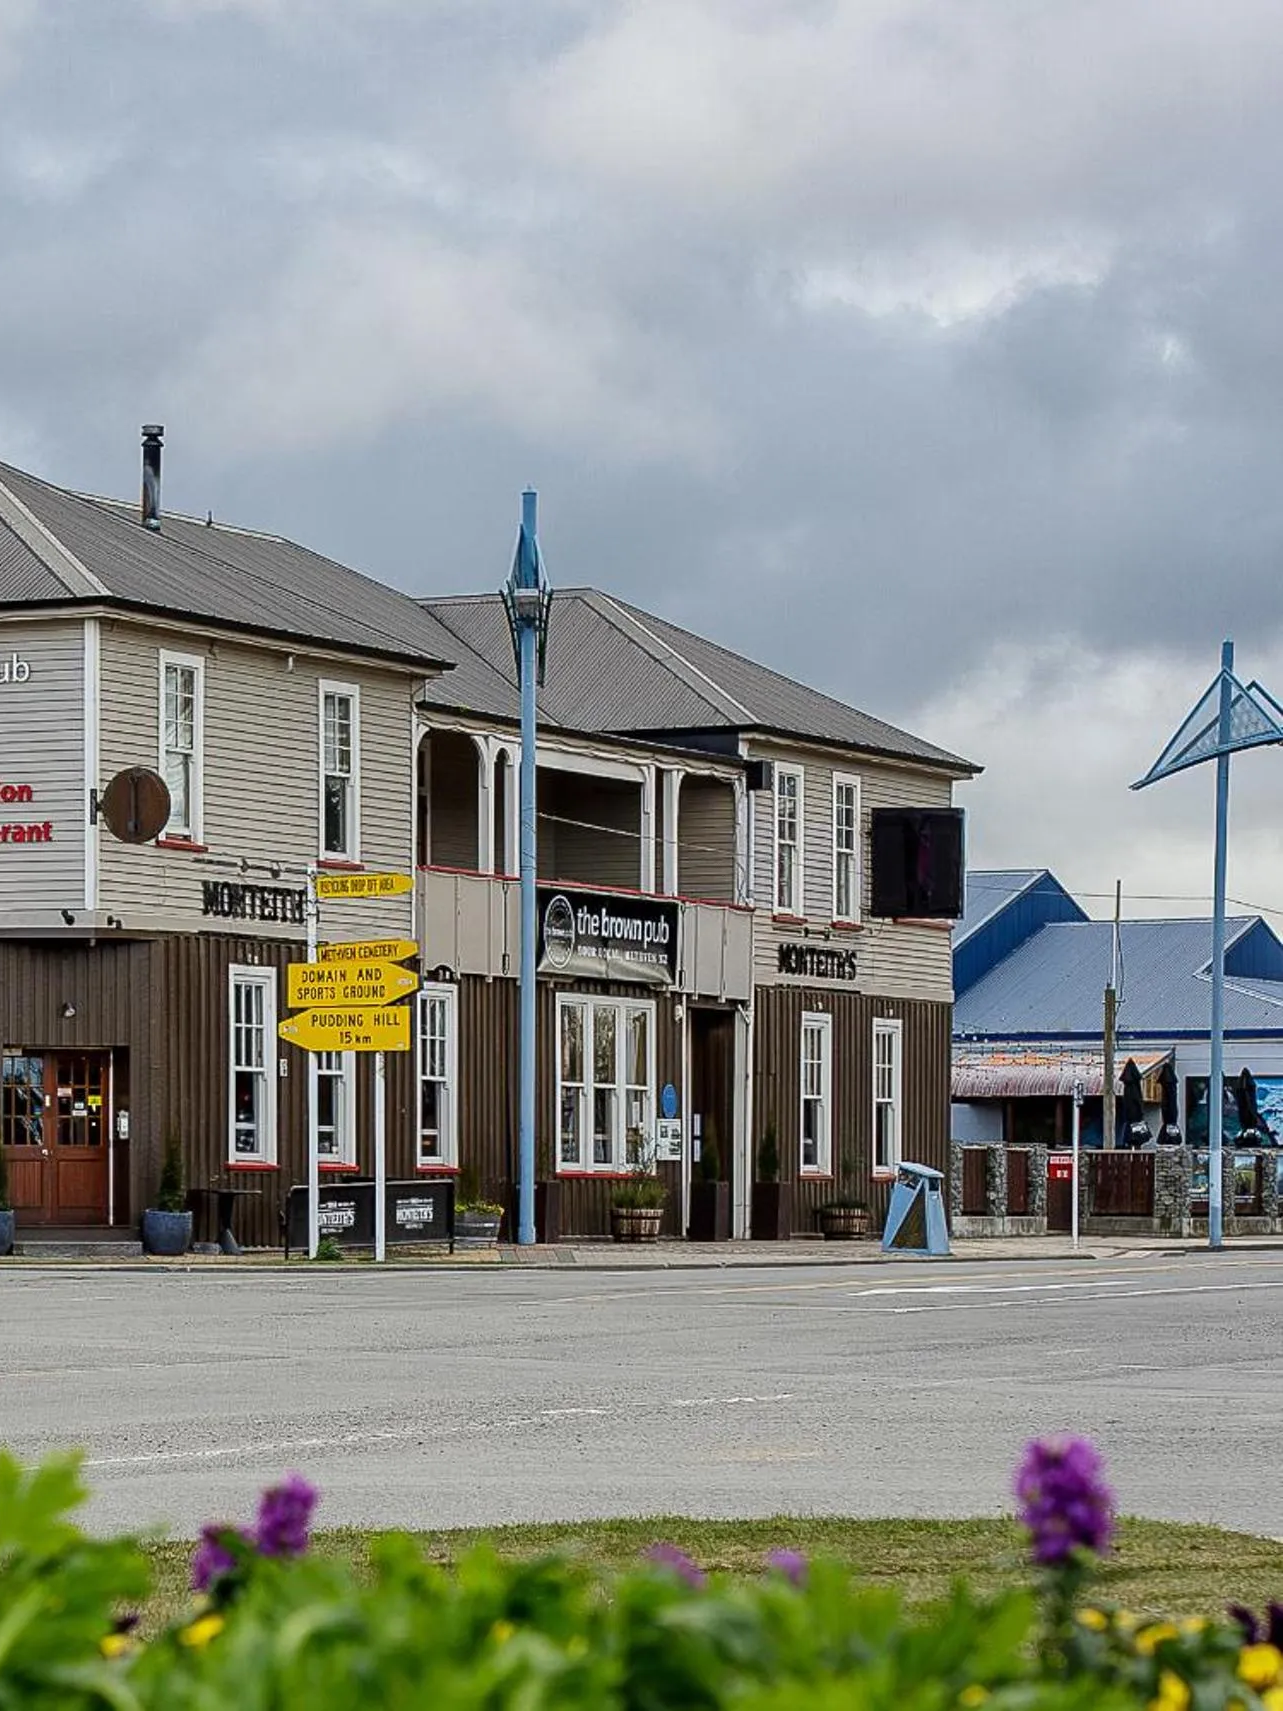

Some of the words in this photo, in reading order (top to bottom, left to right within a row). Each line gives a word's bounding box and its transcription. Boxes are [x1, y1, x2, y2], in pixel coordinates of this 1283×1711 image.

[202, 881, 320, 924] MONTEITH
[577, 905, 599, 936] the
[601, 907, 642, 940] brown
[644, 914, 670, 950] pub
[321, 947, 356, 961] METHVEN
[358, 944, 399, 959] CEMETERY
[778, 944, 857, 980] MONTEITH'S
[301, 969, 347, 983] DOMAIN
[356, 967, 383, 981] AND
[296, 986, 336, 1000] SPORTS
[342, 984, 386, 998] GROUND
[311, 1014, 364, 1027] PUDDING
[373, 1012, 401, 1026] HILL
[339, 1031, 352, 1044] 15
[355, 1034, 372, 1044] km
